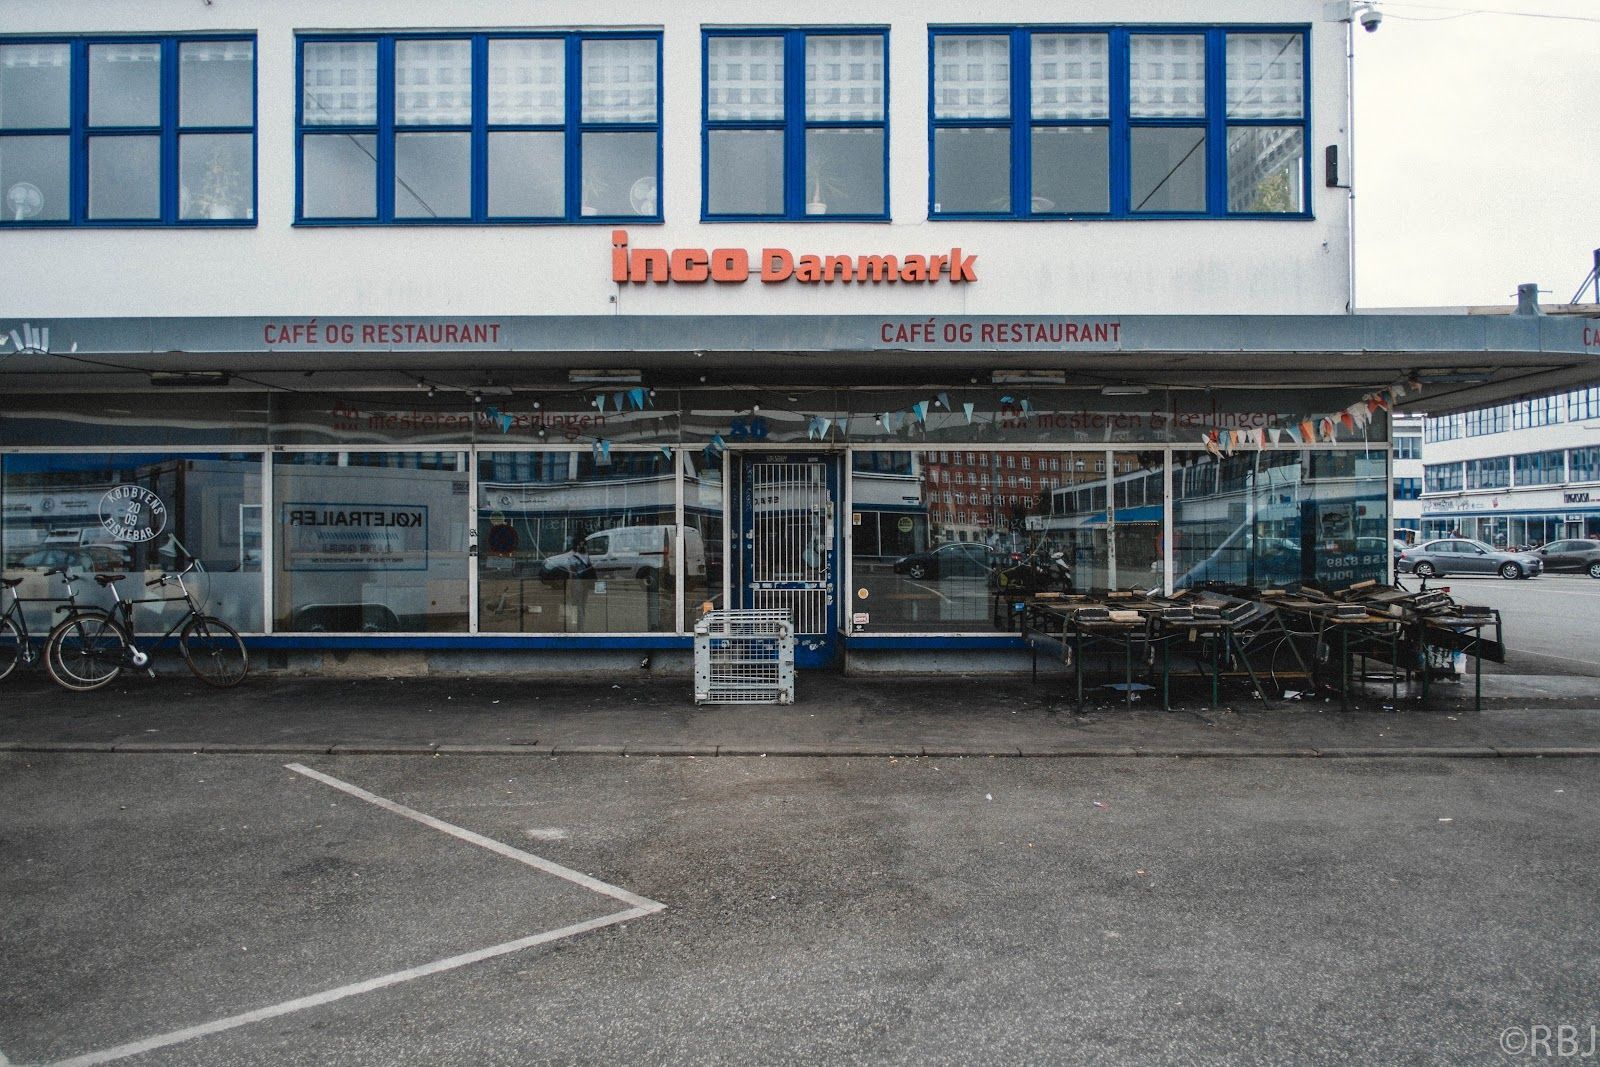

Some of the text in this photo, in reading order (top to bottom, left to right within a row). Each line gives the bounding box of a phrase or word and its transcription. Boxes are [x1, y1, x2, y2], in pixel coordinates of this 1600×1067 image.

[611, 229, 979, 284] inco Danmark
[264, 318, 500, 344] CAFÉ OG RESTAURANT
[881, 318, 1121, 343] CAFÉ OG RESTAURANT
[368, 408, 470, 430] mesteren
[1038, 397, 1279, 431] mesteren & lærlingen
[107, 487, 164, 515] KØDBYENS
[127, 501, 141, 514] 20
[104, 517, 155, 540] FISKEBAR
[124, 513, 138, 526] 09
